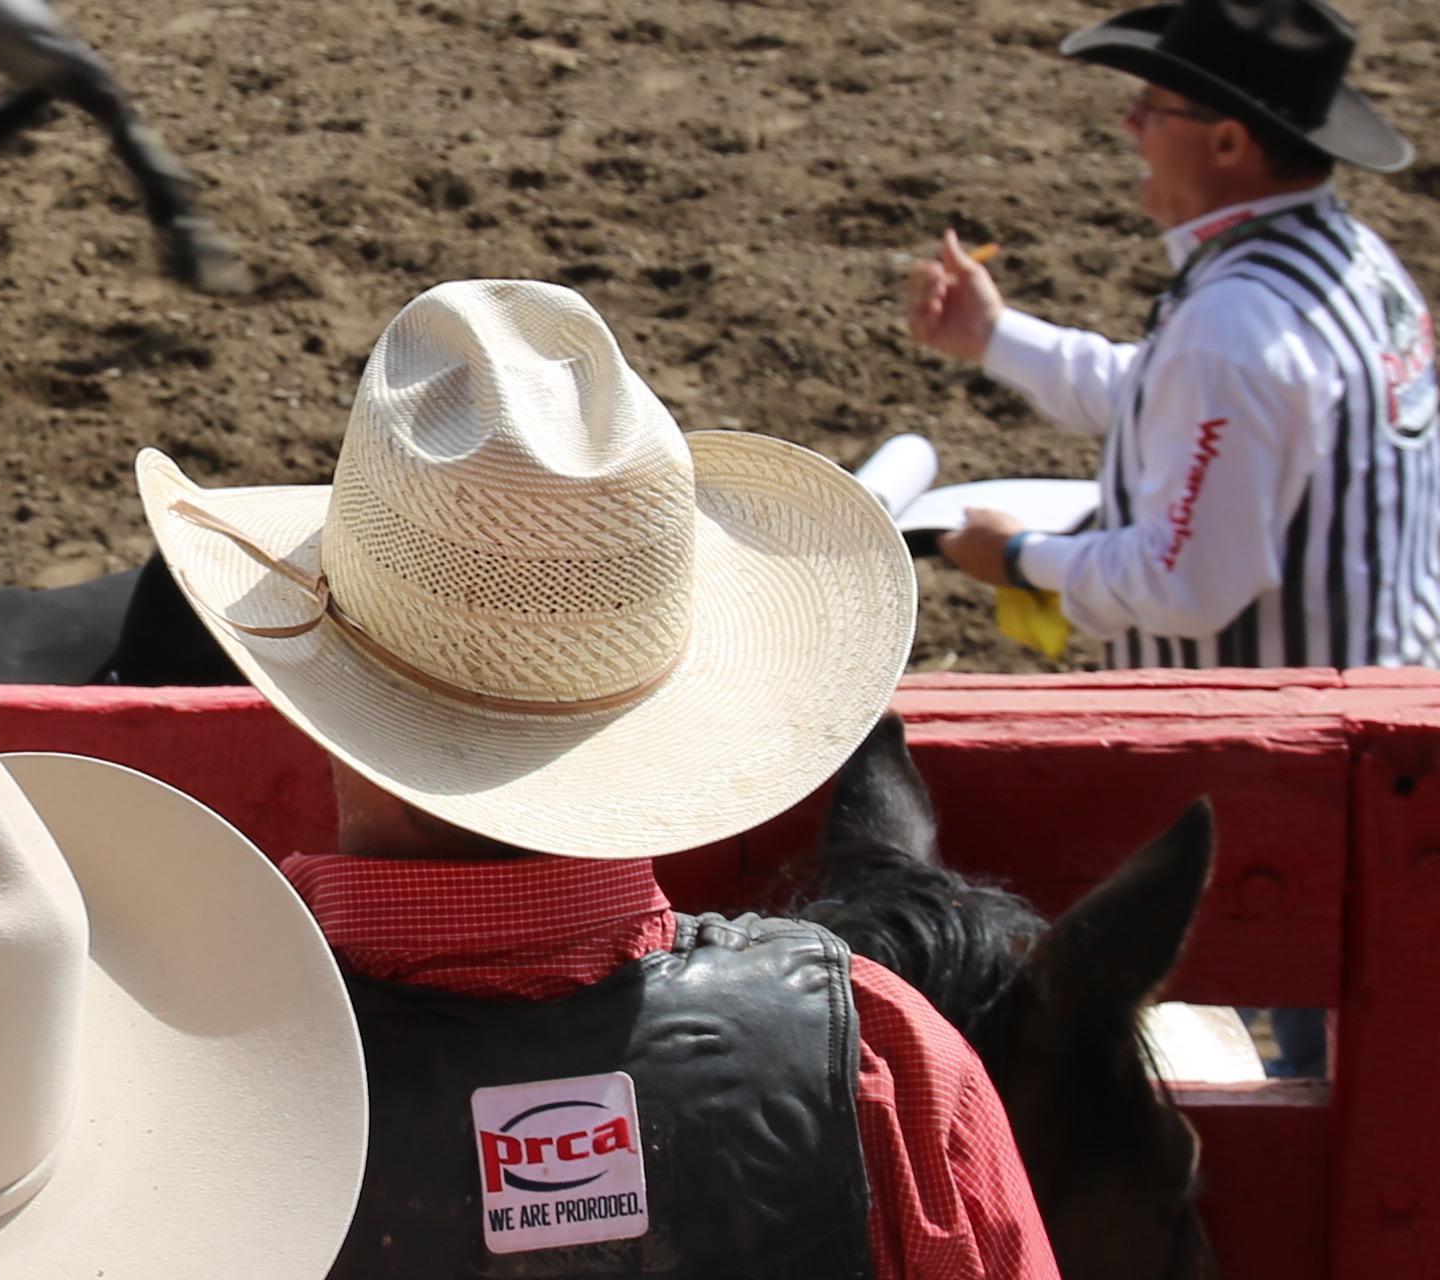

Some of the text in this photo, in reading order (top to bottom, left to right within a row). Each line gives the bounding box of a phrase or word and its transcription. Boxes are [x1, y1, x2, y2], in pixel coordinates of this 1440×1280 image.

[1161, 417, 1229, 572] Wrangler
[480, 1115, 630, 1193] prca
[488, 1207, 516, 1233] WE
[520, 1203, 552, 1230] ARE
